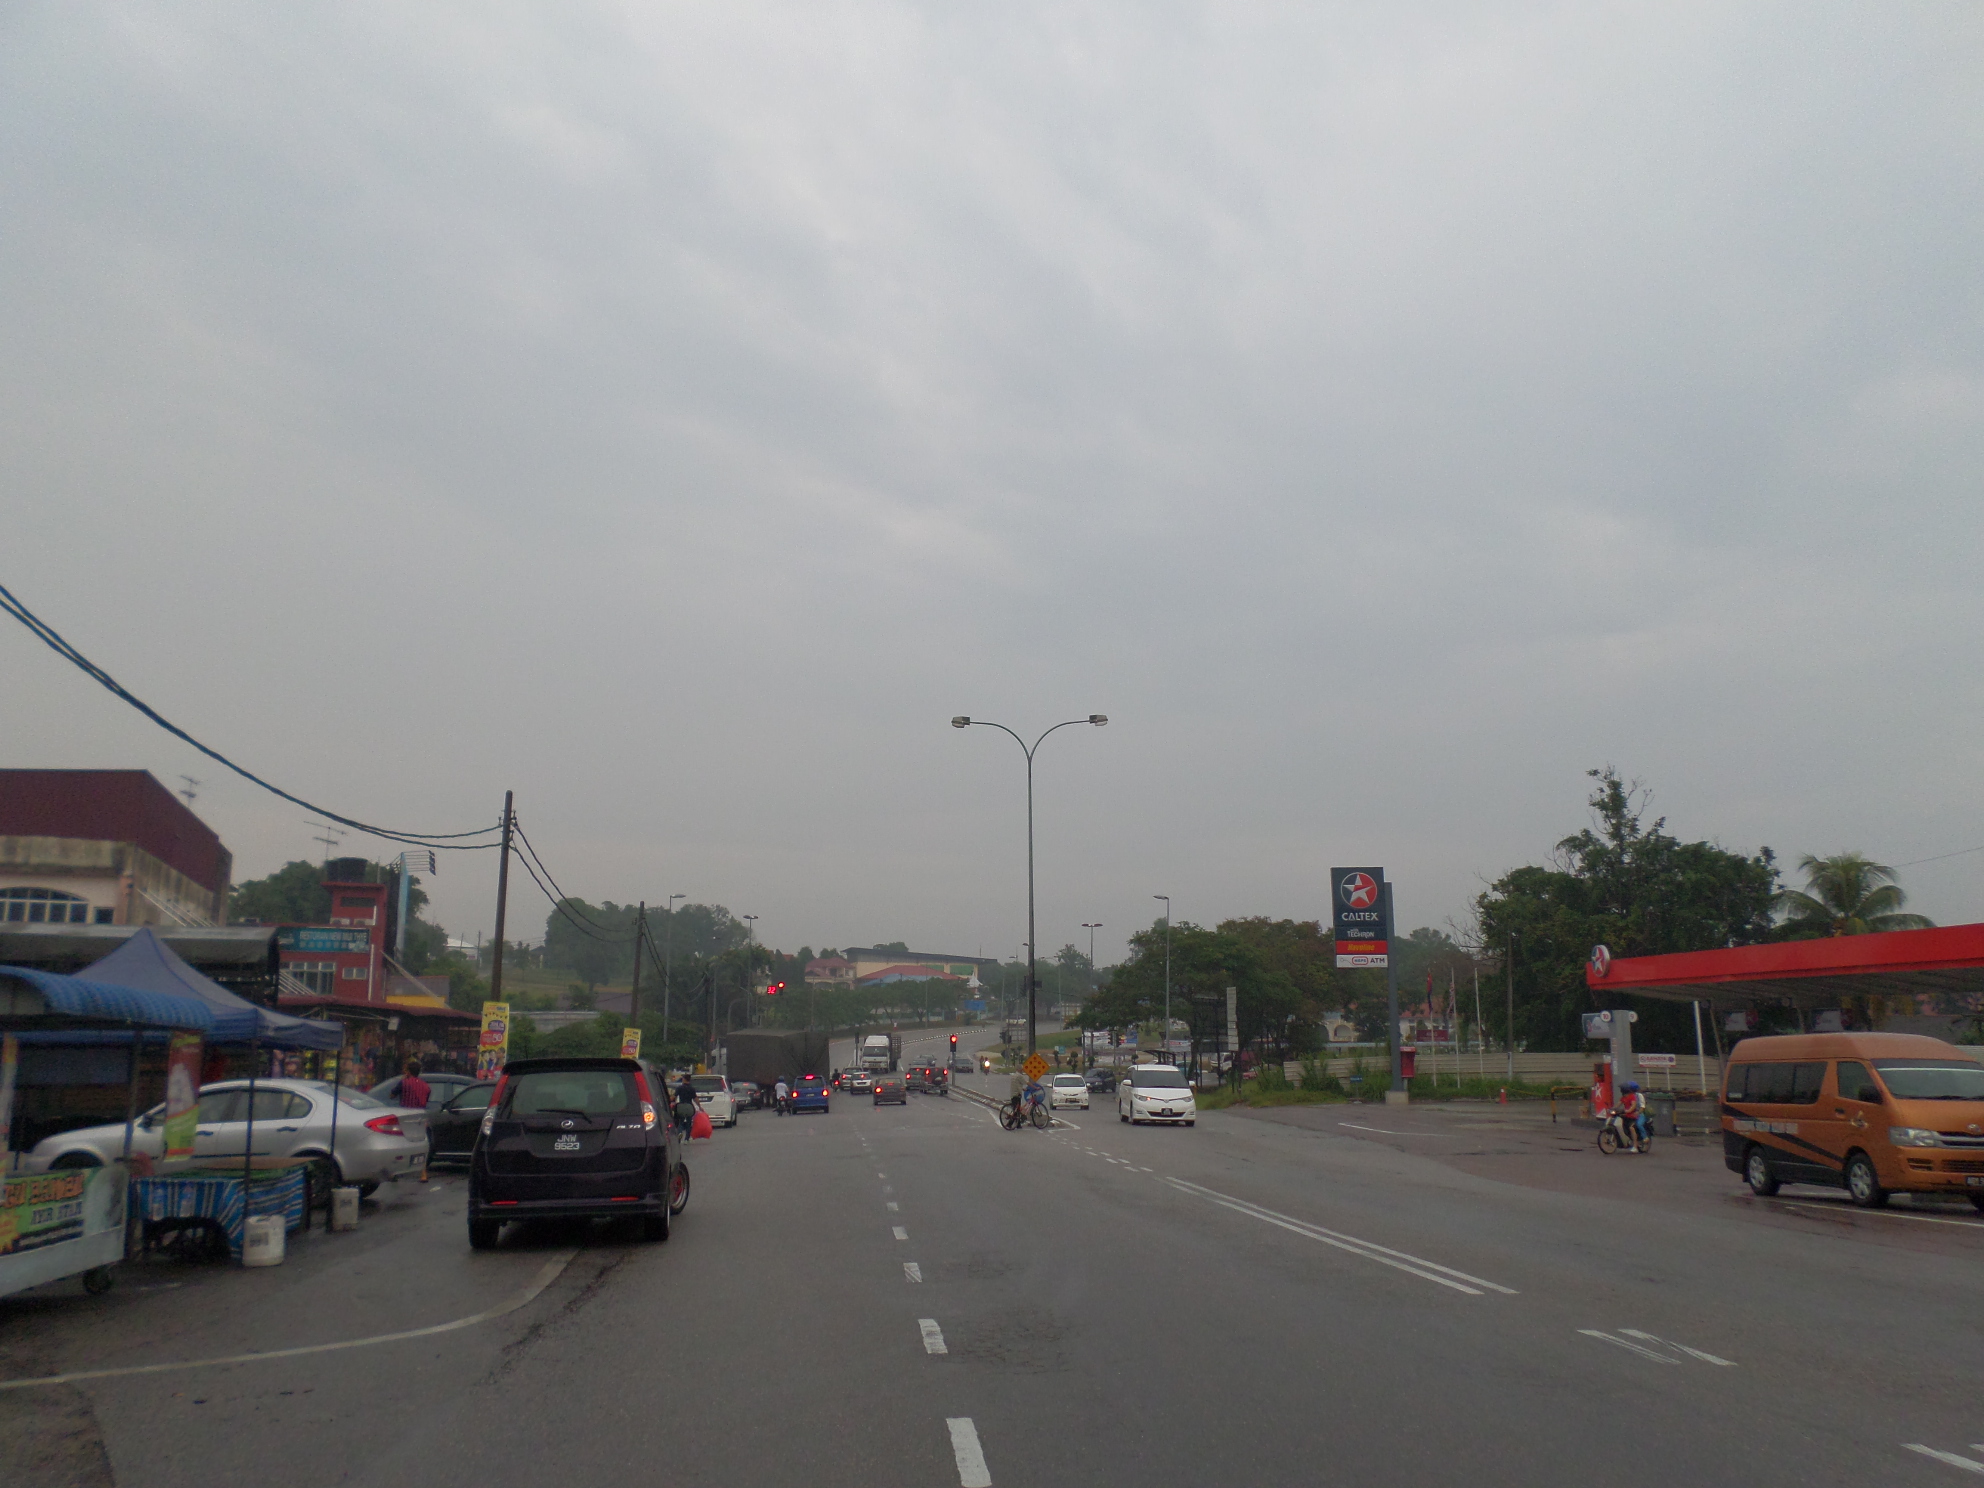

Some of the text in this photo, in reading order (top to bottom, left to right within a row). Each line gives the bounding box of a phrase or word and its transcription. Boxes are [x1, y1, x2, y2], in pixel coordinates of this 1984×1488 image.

[1341, 912, 1379, 921] CALTEX
[1347, 930, 1375, 938] TECHRON
[767, 986, 776, 994] 32
[557, 1134, 577, 1142] JNW
[554, 1142, 580, 1151] 9523
